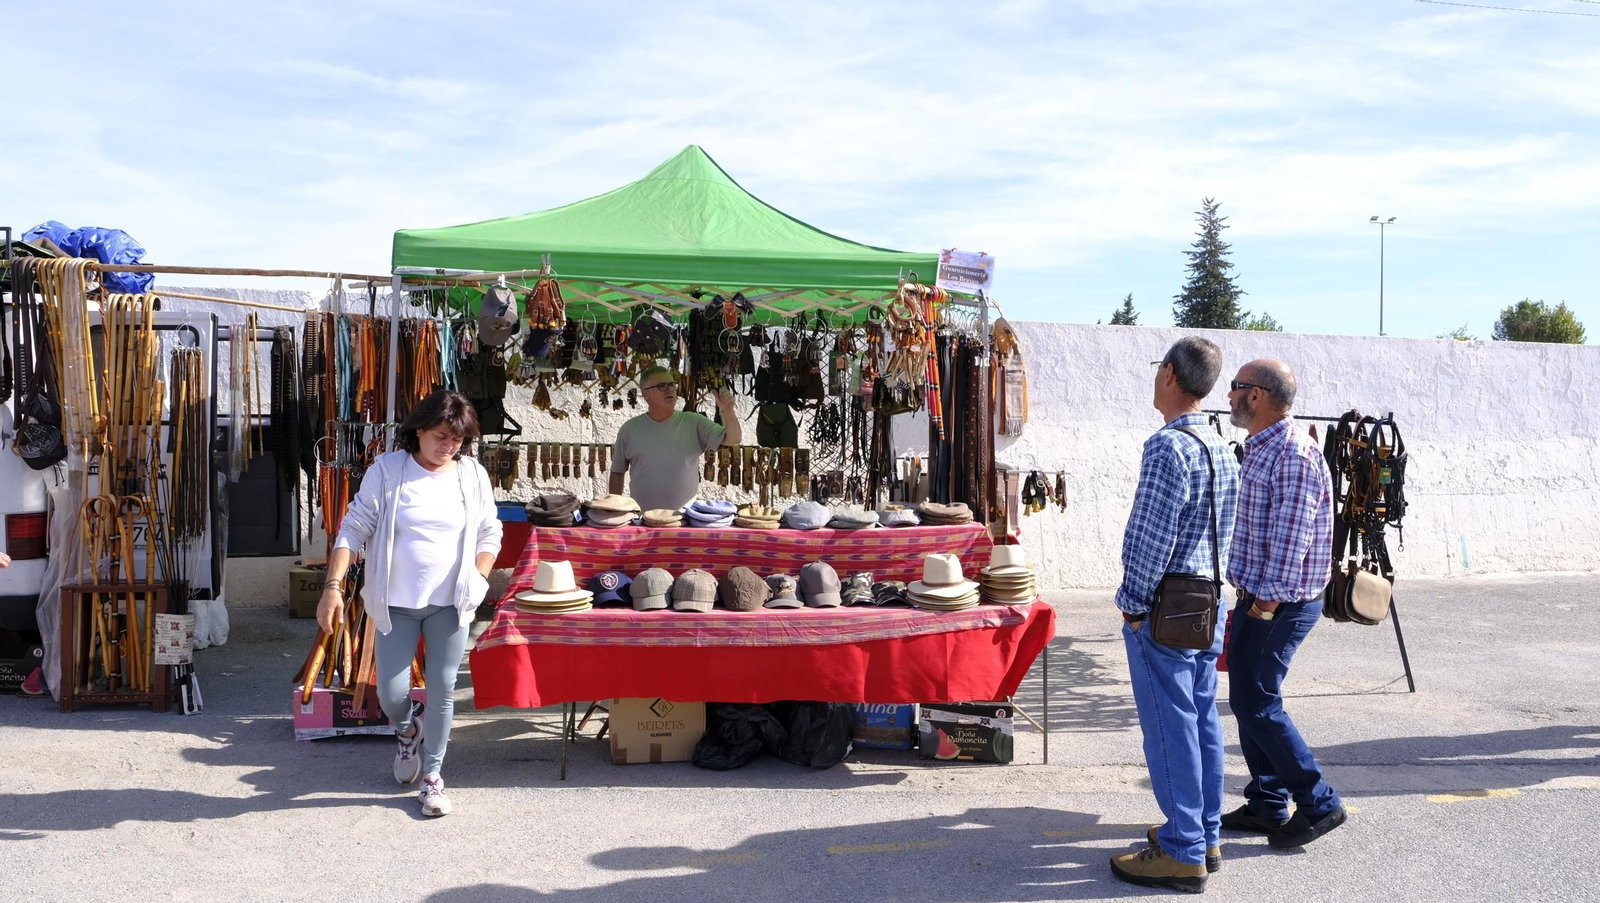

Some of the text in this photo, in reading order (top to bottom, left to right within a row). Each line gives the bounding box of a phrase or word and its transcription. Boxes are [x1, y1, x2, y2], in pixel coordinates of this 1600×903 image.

[947, 273, 958, 281] Los
[637, 719, 685, 731] BEIRETS
[955, 730, 976, 738] Doña
[946, 735, 988, 744] Ramoncita
